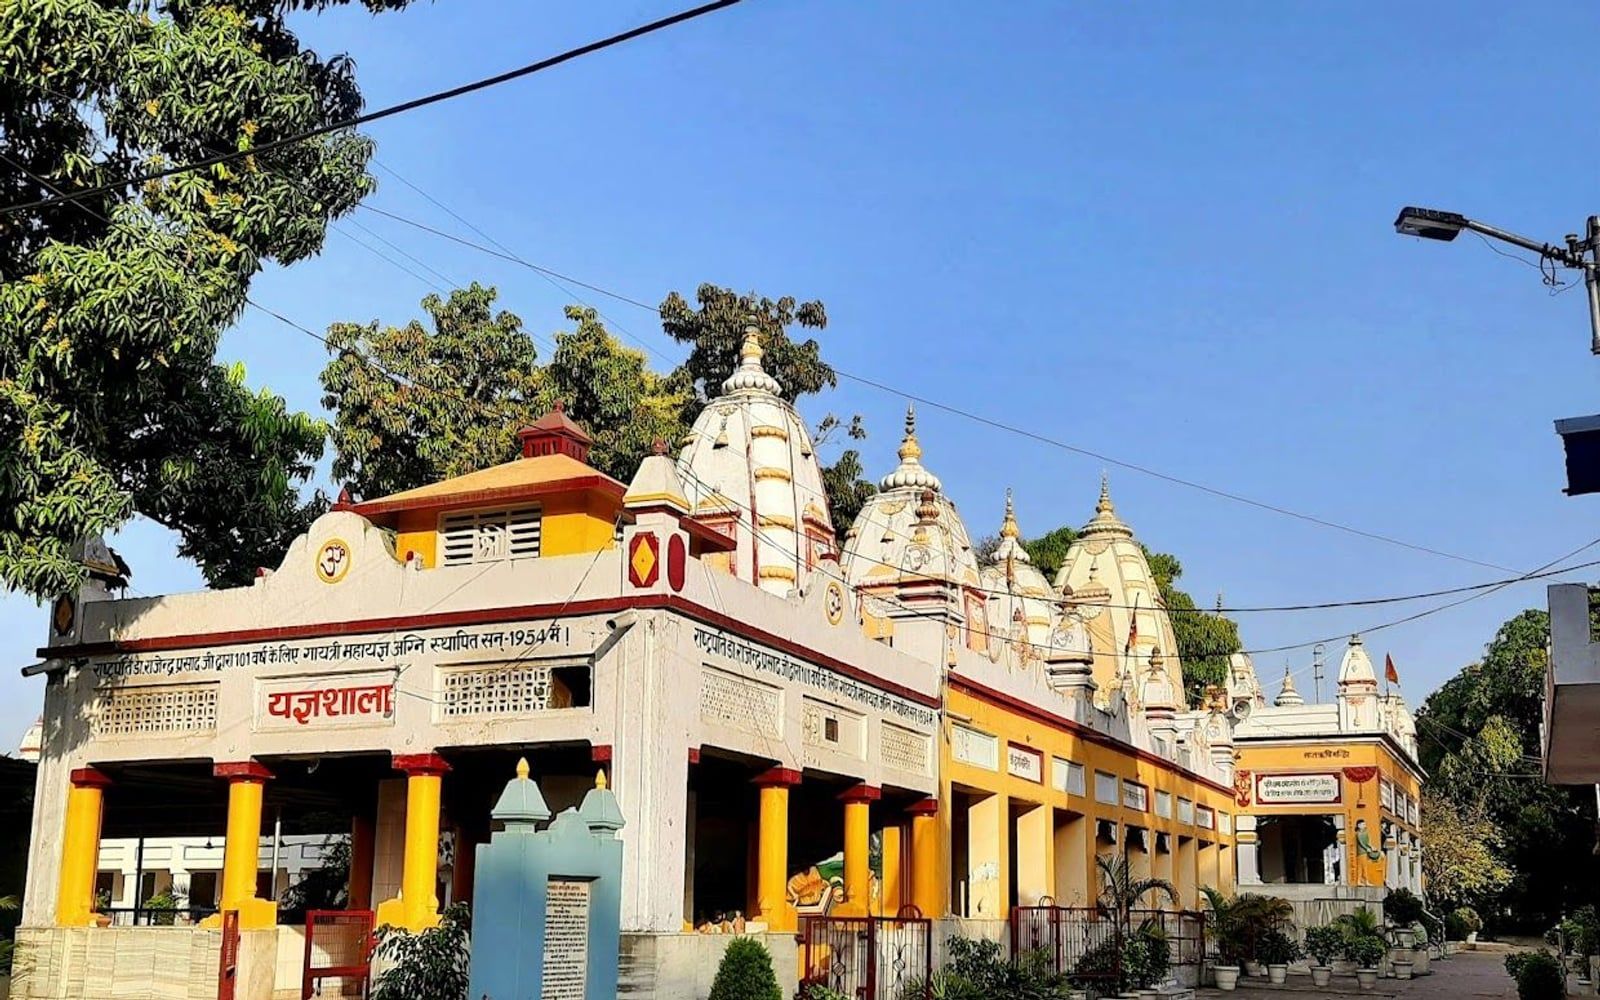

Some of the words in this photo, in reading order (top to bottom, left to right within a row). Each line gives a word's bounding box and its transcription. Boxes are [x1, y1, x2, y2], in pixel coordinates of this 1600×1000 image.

[201, 652, 214, 670] जी
[215, 653, 234, 671] द्वारा
[235, 652, 250, 669] 101
[252, 646, 267, 665] वर्ष
[303, 641, 342, 661] गायत्री
[343, 642, 391, 661] महायज्ञ
[392, 634, 425, 656] अग्नि
[430, 630, 478, 652] स्थापित
[268, 685, 393, 724] यज्ञशाला
